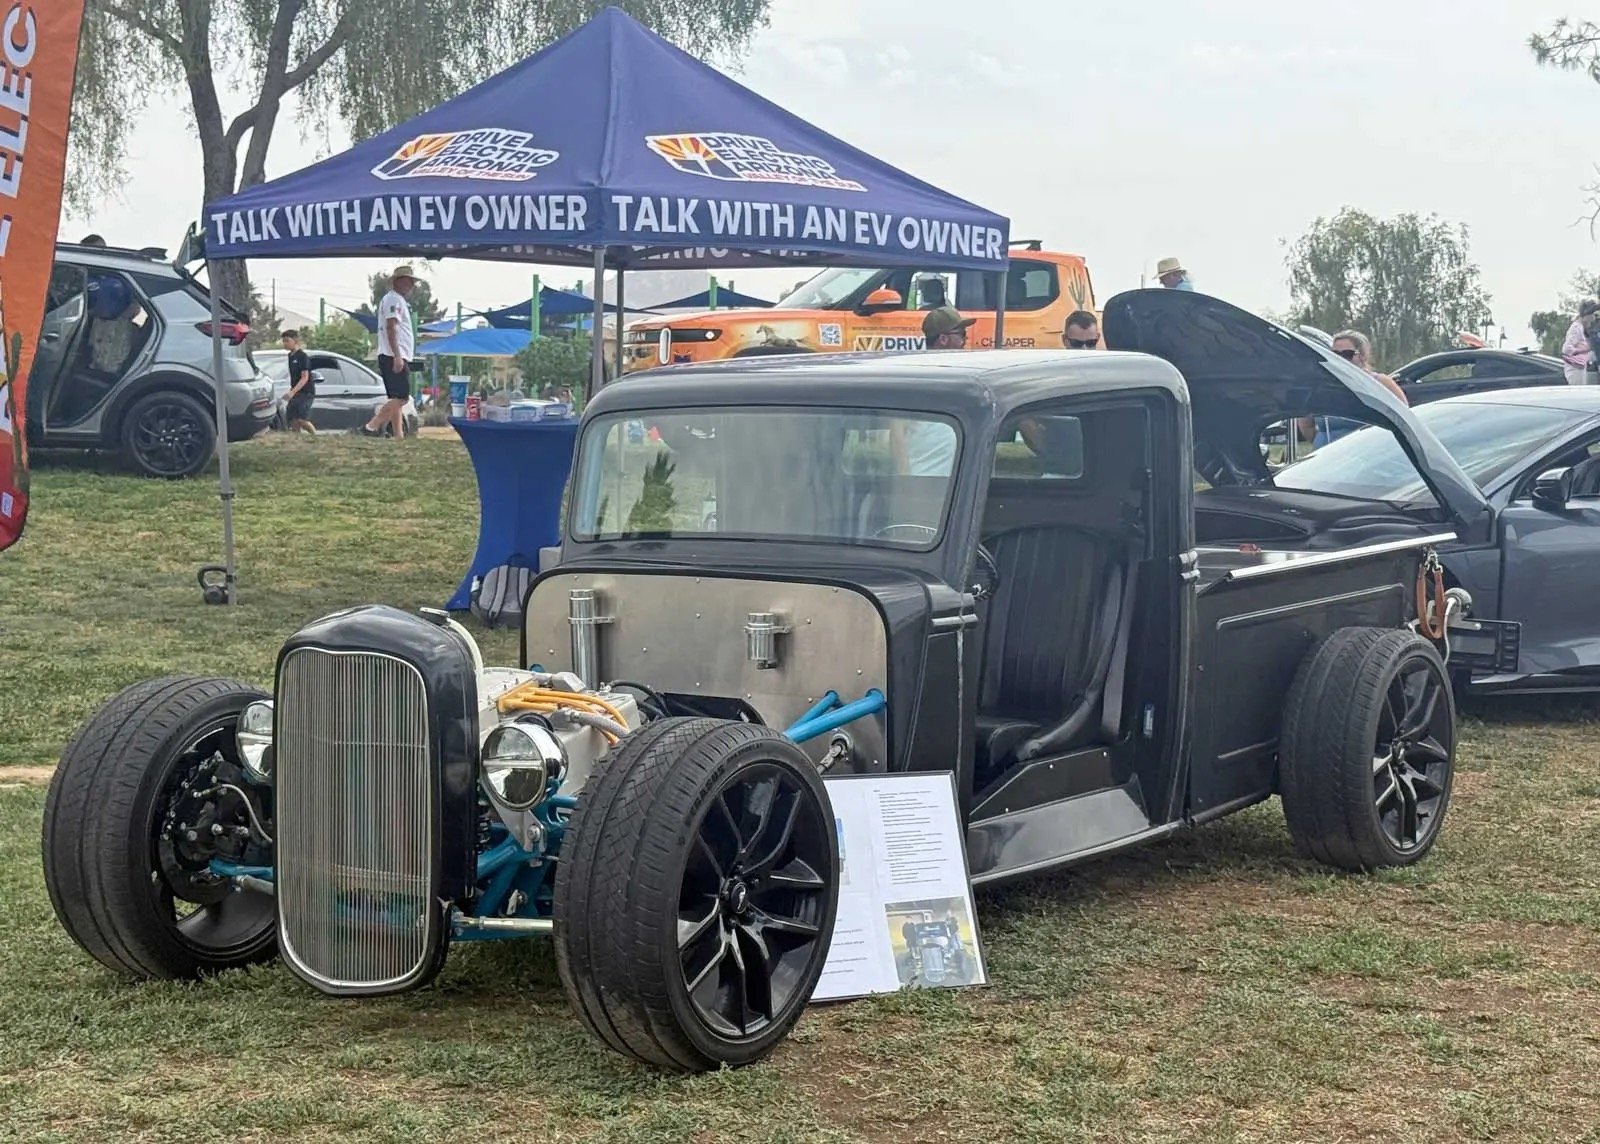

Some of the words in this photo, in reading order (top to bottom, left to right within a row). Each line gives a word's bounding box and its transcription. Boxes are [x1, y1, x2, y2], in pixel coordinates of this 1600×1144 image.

[455, 131, 525, 148] DRIVE
[703, 136, 775, 151] DRIVE
[440, 146, 553, 164] ELECTRIC
[722, 151, 832, 170] ELECTRIC
[426, 157, 525, 172] ARIZONA
[732, 162, 834, 179] ARIZONA
[211, 207, 281, 245] TALK
[285, 200, 361, 237] WITH
[368, 198, 413, 231] AN
[419, 195, 459, 230] EV
[465, 194, 588, 230] OWNER
[611, 195, 701, 234] TALK
[707, 200, 795, 237] WITH
[803, 206, 848, 242] AN
[855, 211, 892, 246] EV
[898, 217, 1002, 260] OWNER
[885, 337, 926, 350] DRIV
[981, 338, 1035, 347] CHAPER
